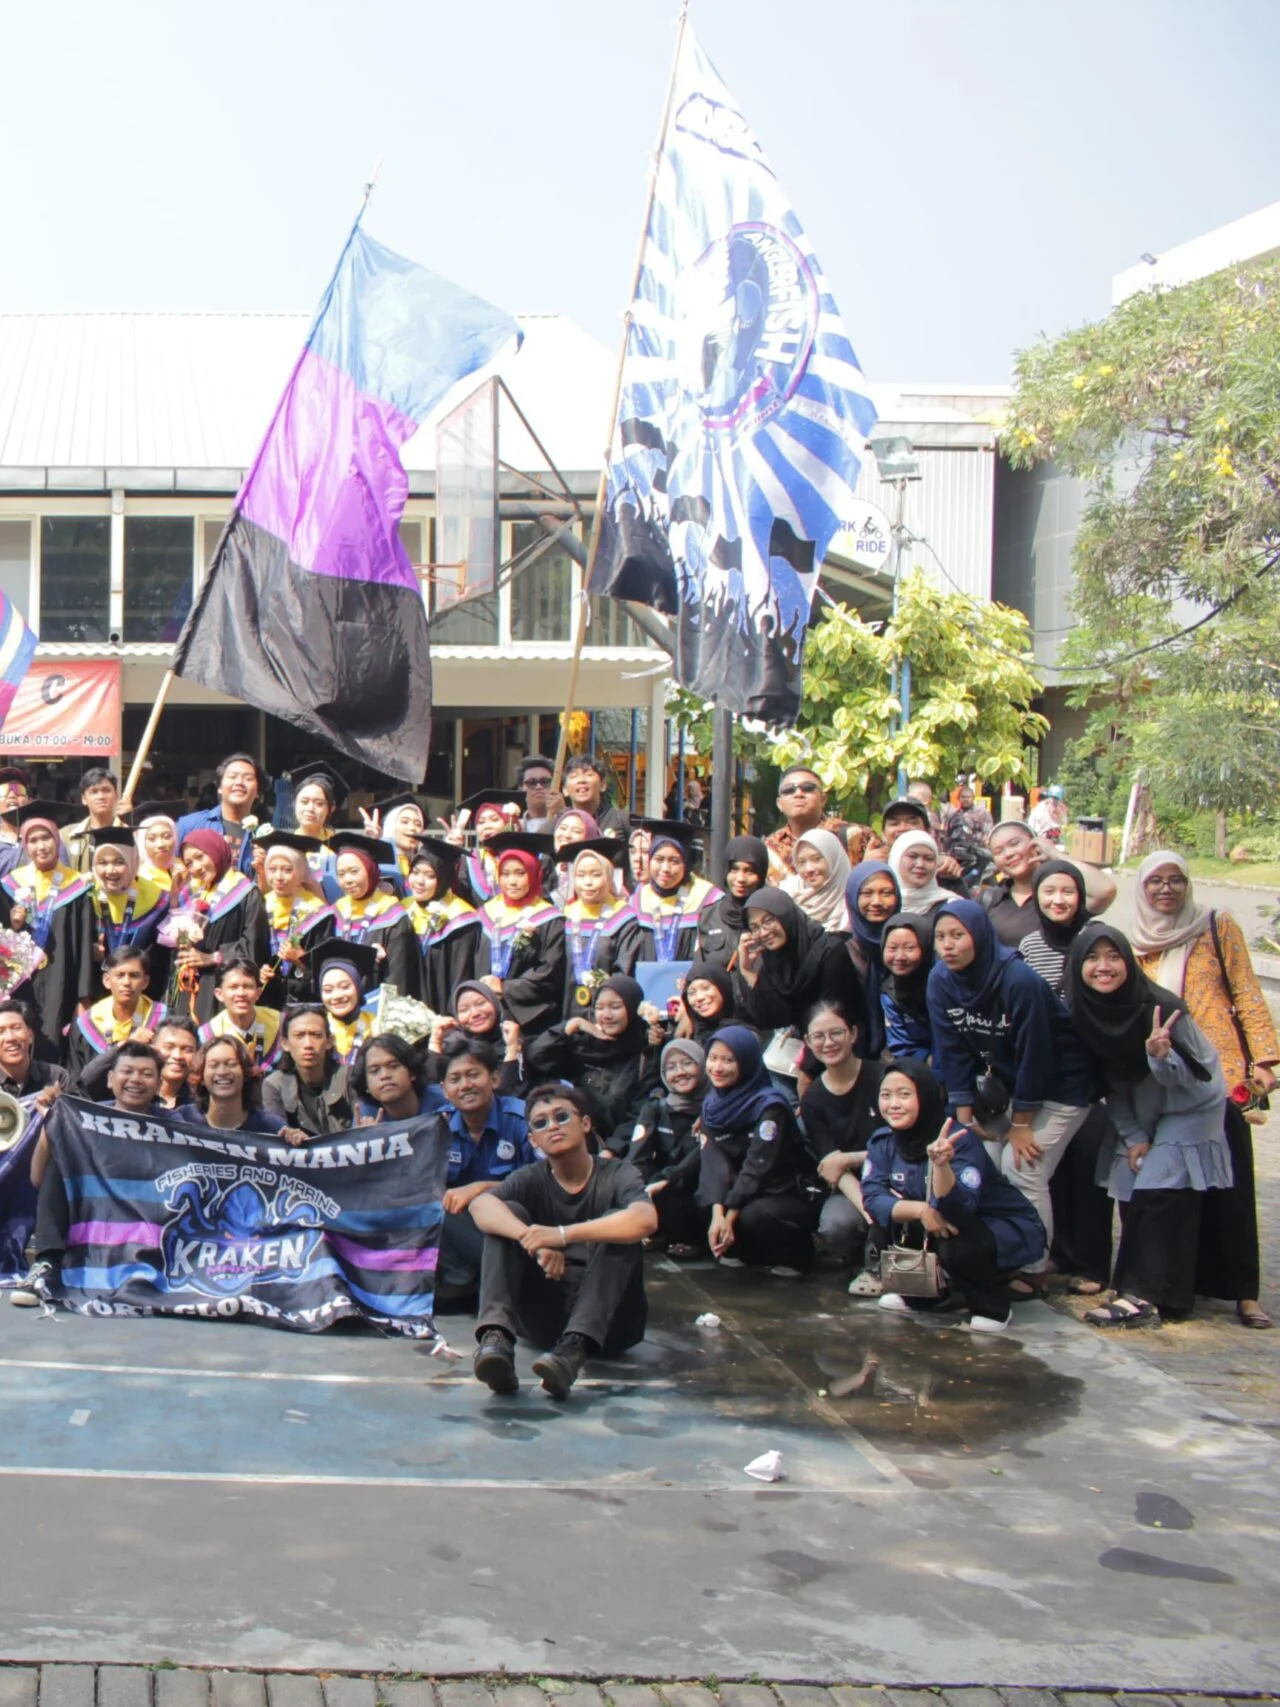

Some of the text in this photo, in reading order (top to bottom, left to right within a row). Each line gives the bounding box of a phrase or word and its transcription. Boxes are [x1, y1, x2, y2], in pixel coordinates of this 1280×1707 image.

[836, 519, 857, 533] RK
[855, 539, 887, 553] RIDE
[41, 674, 65, 705] C
[79, 1110, 414, 1169] KRAKEN MANIA
[154, 1162, 341, 1219] FISHERIES AND MARINE
[169, 1234, 305, 1277] KRAKEN
